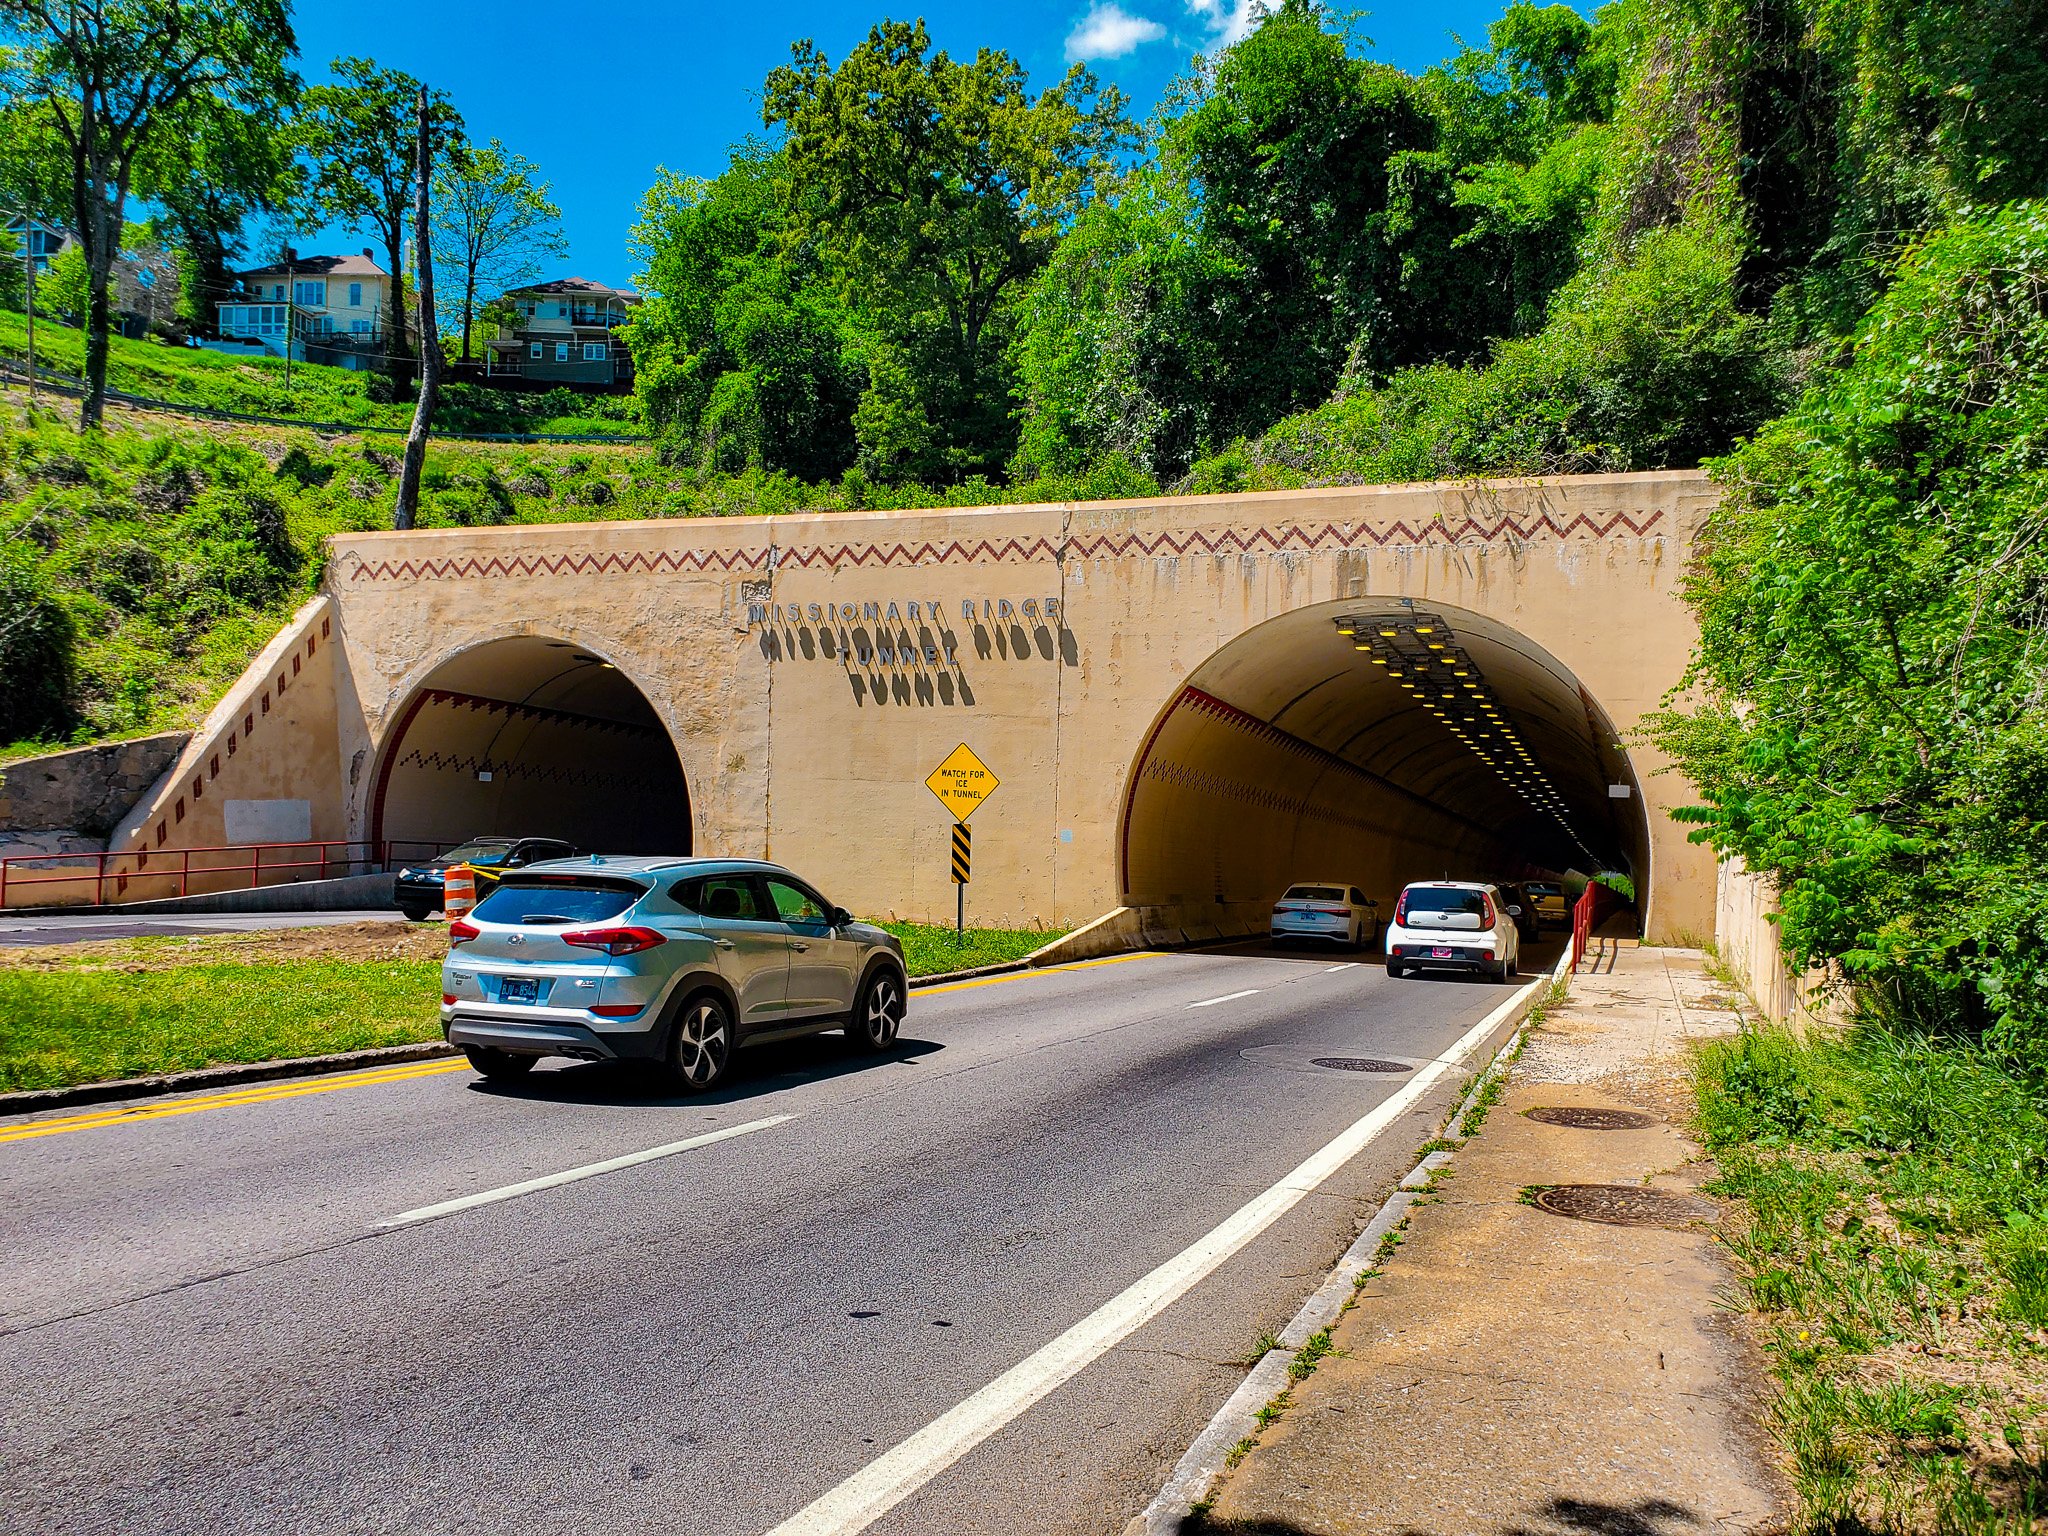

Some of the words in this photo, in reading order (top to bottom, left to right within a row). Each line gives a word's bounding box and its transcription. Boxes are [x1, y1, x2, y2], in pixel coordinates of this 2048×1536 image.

[748, 601, 940, 622] MISSIONARY
[962, 598, 1058, 620] RIDGE
[836, 647, 958, 666] TUNNEL
[941, 769, 966, 778] WATCH
[953, 790, 982, 799] TUNNEL
